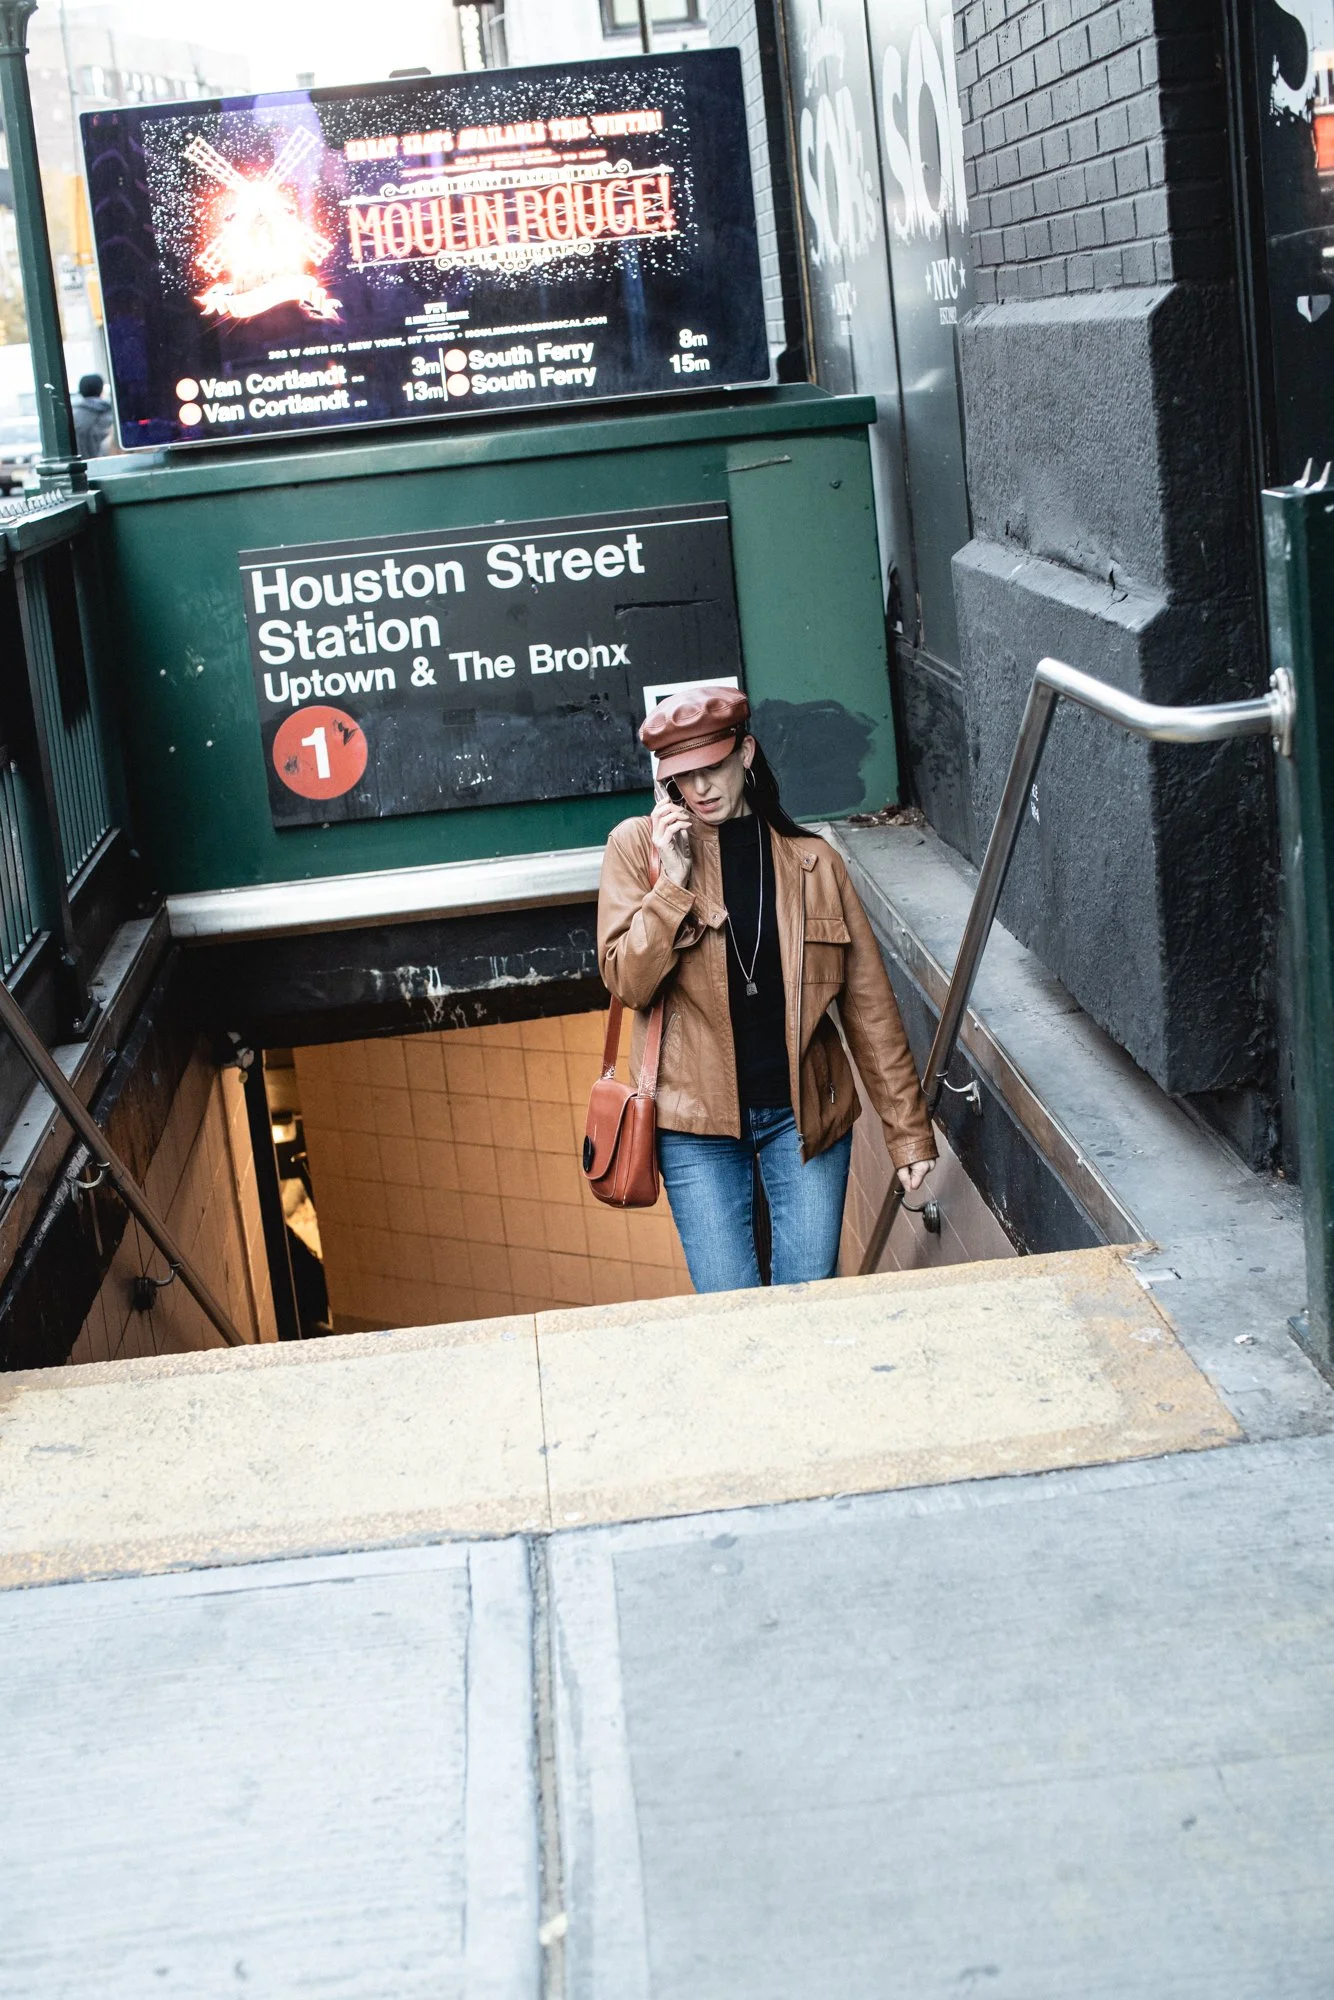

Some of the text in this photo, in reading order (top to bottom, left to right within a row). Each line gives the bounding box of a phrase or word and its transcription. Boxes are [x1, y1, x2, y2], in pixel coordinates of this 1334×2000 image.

[345, 110, 664, 161] GREAT SEATS AVAILABLE THIS WINTER!
[347, 175, 675, 262] MOULIN ROUGE!
[931, 256, 958, 300] NYC
[348, 340, 373, 351] NEW
[408, 335, 422, 345] NY
[468, 329, 709, 370] South Ferry 8m
[200, 378, 242, 399] Van
[246, 365, 347, 394] Cortlandt
[411, 356, 441, 377] 3m
[471, 353, 711, 395] South Ferry 15m
[203, 403, 245, 423] Van
[249, 390, 350, 418] Cortlandt
[402, 381, 444, 402] 13m
[251, 534, 645, 615] Houston Street
[257, 611, 441, 666] Station
[263, 643, 631, 706] Uptown & The Bronx
[301, 726, 331, 779] 1
